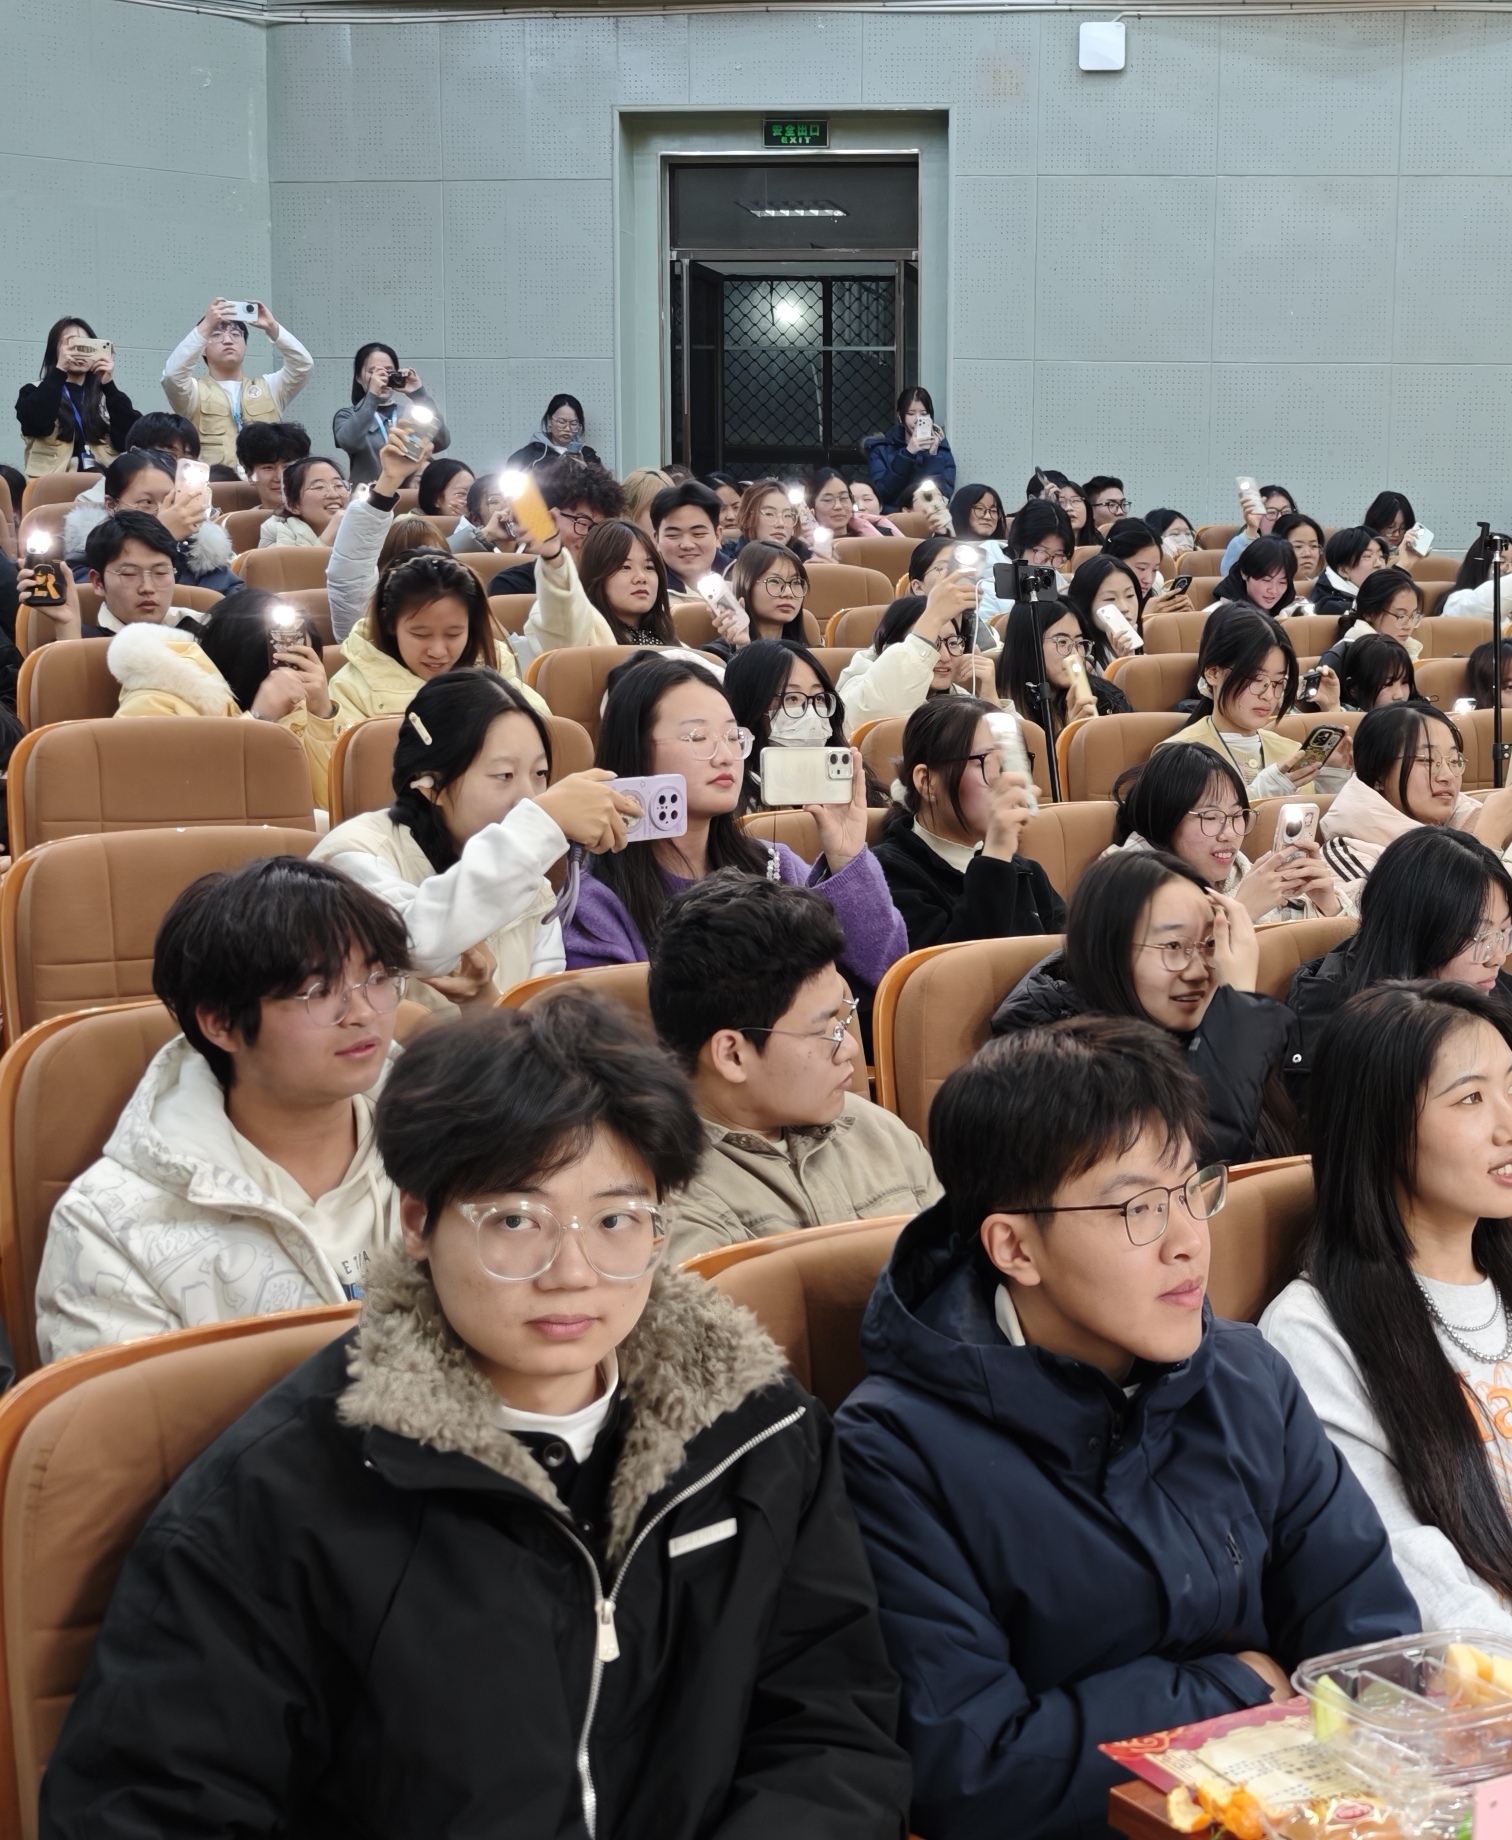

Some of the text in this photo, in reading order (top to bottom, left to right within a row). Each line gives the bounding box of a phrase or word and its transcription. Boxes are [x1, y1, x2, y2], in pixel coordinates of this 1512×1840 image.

[771, 124, 820, 136] 安全出口
[781, 136, 811, 144] EXIT
